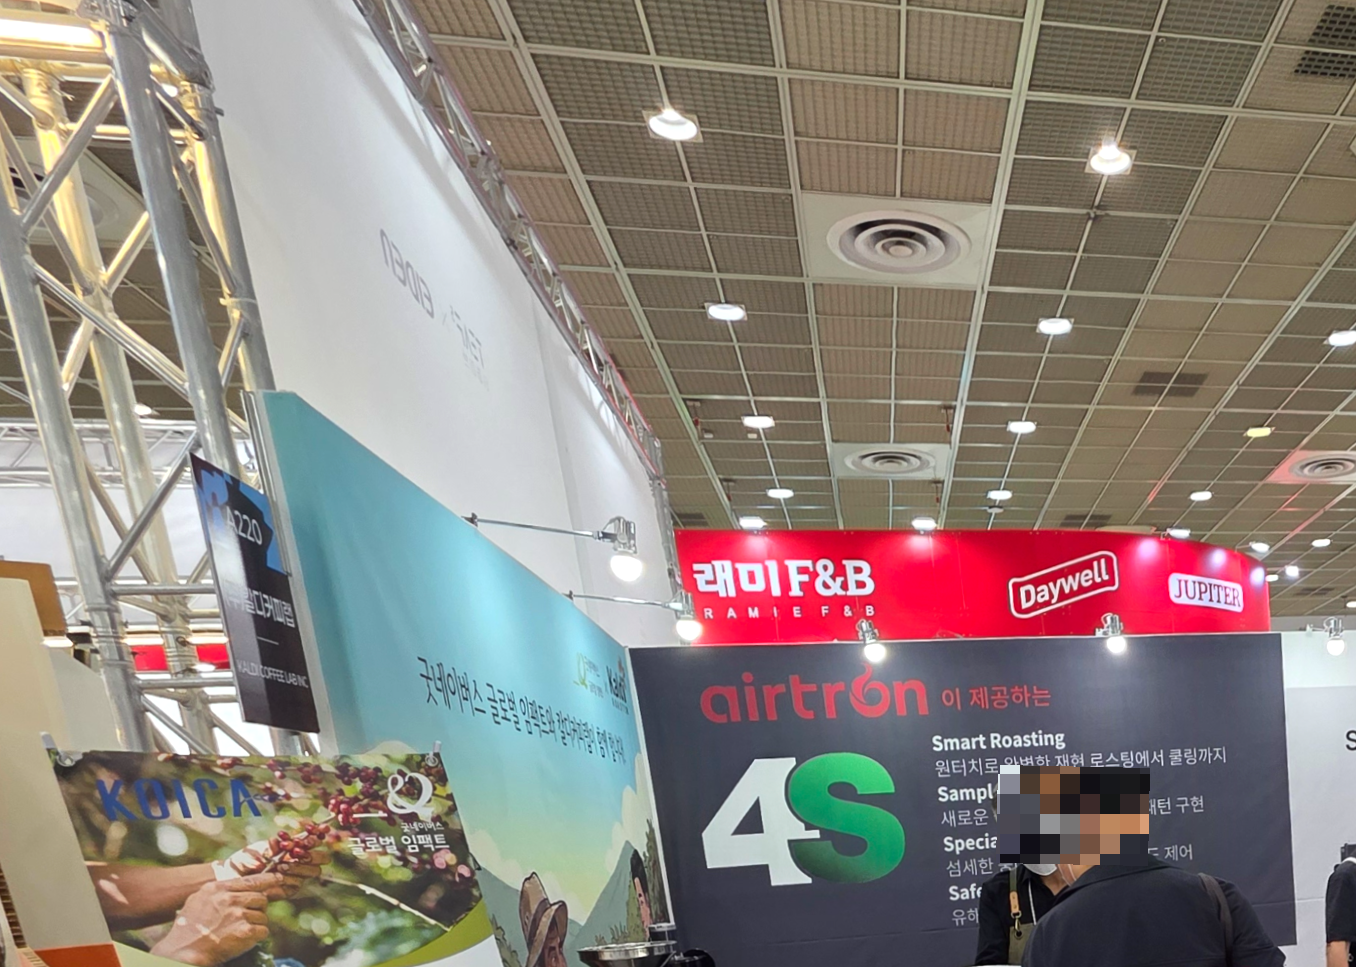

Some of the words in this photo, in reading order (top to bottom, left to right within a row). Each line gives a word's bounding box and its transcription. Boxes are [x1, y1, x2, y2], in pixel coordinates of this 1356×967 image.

[225, 504, 264, 546] A220
[1019, 557, 1109, 609] Daywell
[1174, 579, 1242, 608] JUPITER
[703, 606, 802, 619] RAMIE
[821, 605, 875, 618] F&B
[260, 664, 285, 683] COFFEE
[285, 668, 298, 686] LAB
[417, 656, 486, 717] 굿네이버스
[486, 683, 521, 731] 글로벌
[519, 695, 557, 743] 임팩트와
[941, 687, 962, 711] 이
[969, 685, 1052, 710] 제공하는
[932, 734, 986, 752] Smart
[990, 730, 1066, 750] Roasting
[935, 757, 999, 779] 원터치로
[1090, 749, 1165, 769] 로스팅에서
[1168, 746, 1228, 766] 쿨링까지
[95, 776, 262, 821] KOICA
[938, 783, 996, 805] Sampl
[941, 808, 989, 828] 새로운
[1175, 795, 1205, 814] 구현
[401, 821, 445, 833] 굿네이버스
[348, 835, 399, 853] 글로벌
[401, 833, 450, 852] 임팩트
[946, 858, 994, 878] 섬세한
[1164, 843, 1193, 861] 제어
